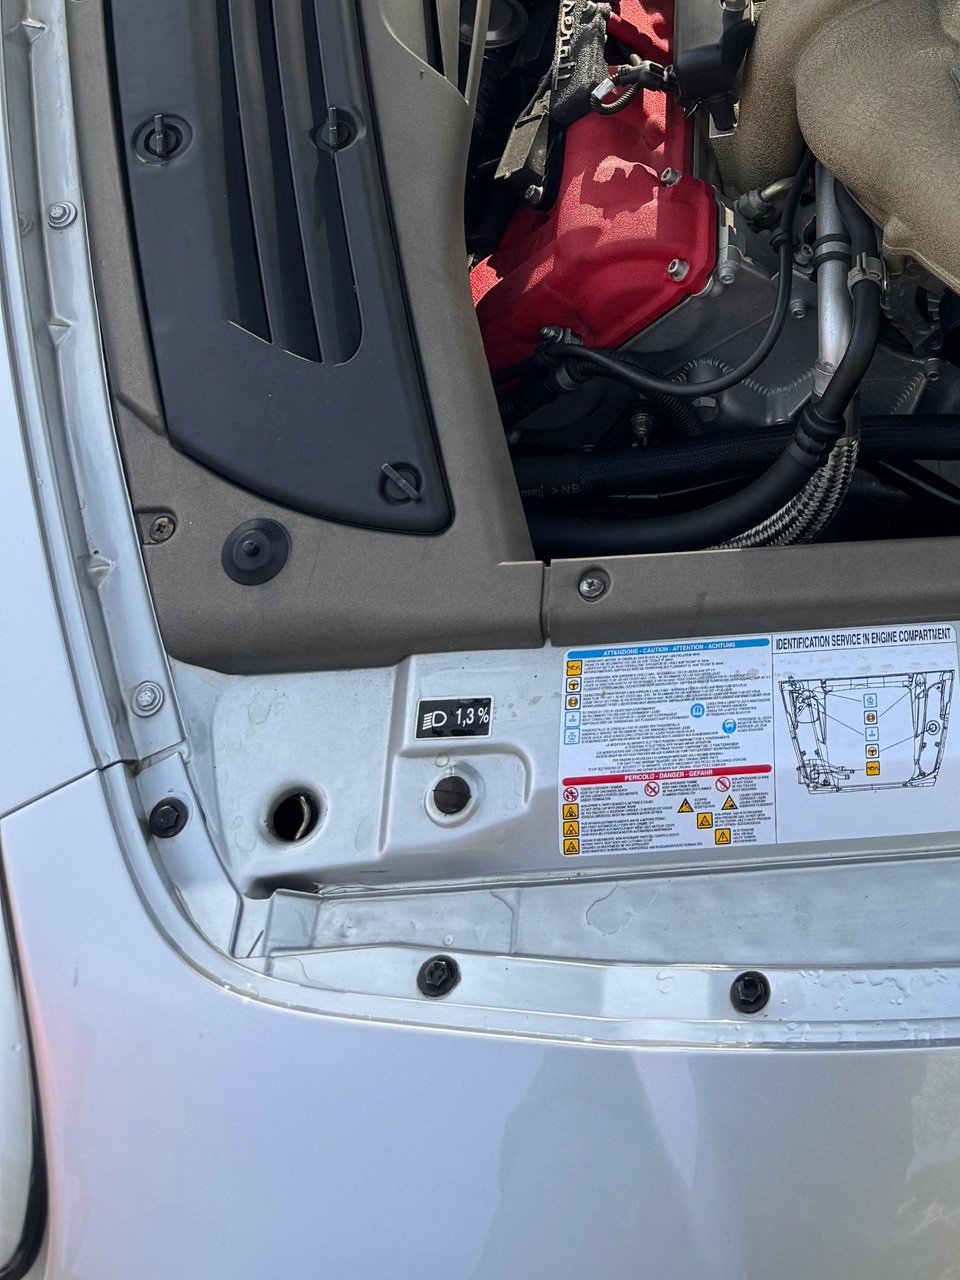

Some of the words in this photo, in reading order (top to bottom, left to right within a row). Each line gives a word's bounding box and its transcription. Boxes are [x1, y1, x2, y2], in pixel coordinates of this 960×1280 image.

[776, 635, 830, 650] IDENTIFICATION
[831, 633, 861, 647] SERVICE
[862, 632, 870, 645] IN
[871, 631, 898, 644] ENGINE
[899, 627, 951, 642] COMPARTMENT
[603, 648, 639, 656] ATTENZIONE
[643, 646, 668, 654] CAUTION
[672, 643, 704, 651] ATTENTION
[708, 641, 736, 649] ACHTUNG
[624, 774, 654, 782] PERICOLO
[659, 771, 685, 779] DANGER
[688, 769, 713, 777] GEFAHR
